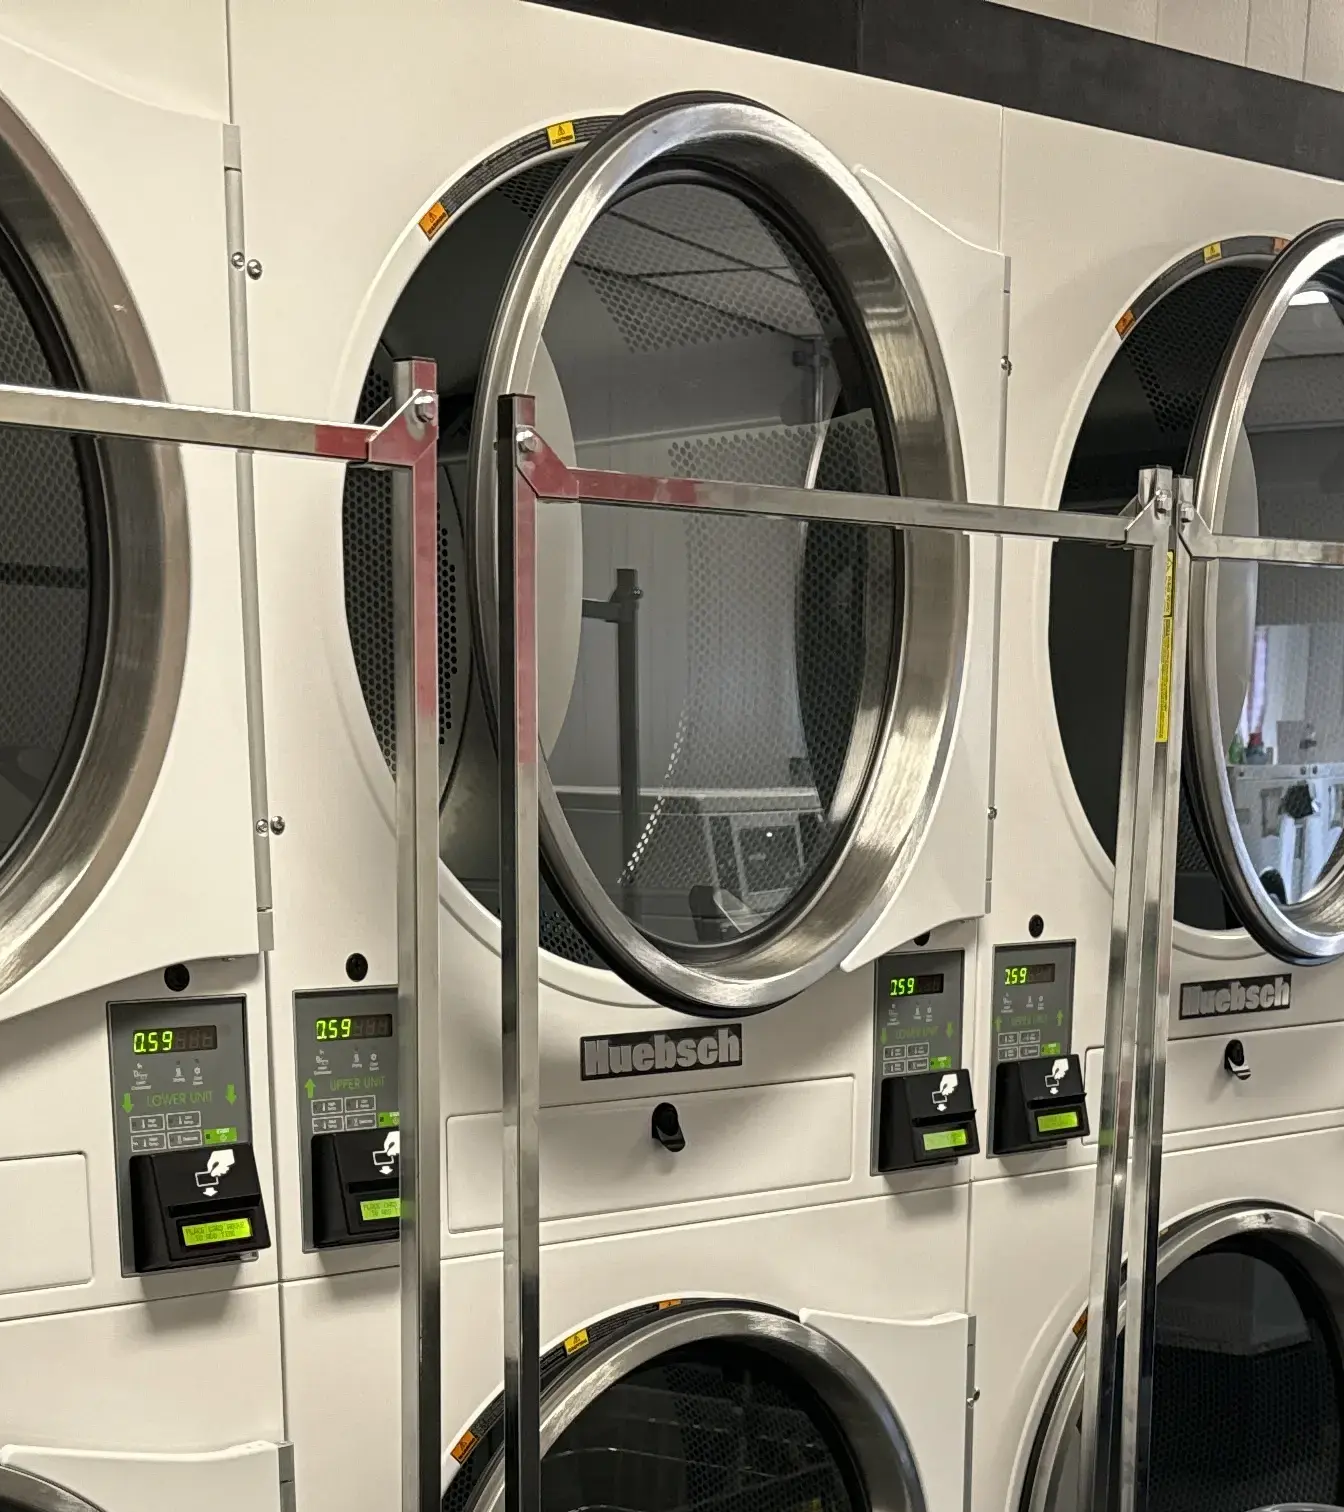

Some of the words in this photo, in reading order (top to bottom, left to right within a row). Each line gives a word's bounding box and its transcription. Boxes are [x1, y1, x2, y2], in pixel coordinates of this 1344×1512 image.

[1181, 976, 1290, 1017] Huebsch
[584, 1028, 740, 1076] Huebsch
[146, 1092, 186, 1107] LOWER
[189, 1090, 213, 1104] UNIT
[329, 1077, 361, 1092] UPPER
[364, 1076, 386, 1089] UNIT
